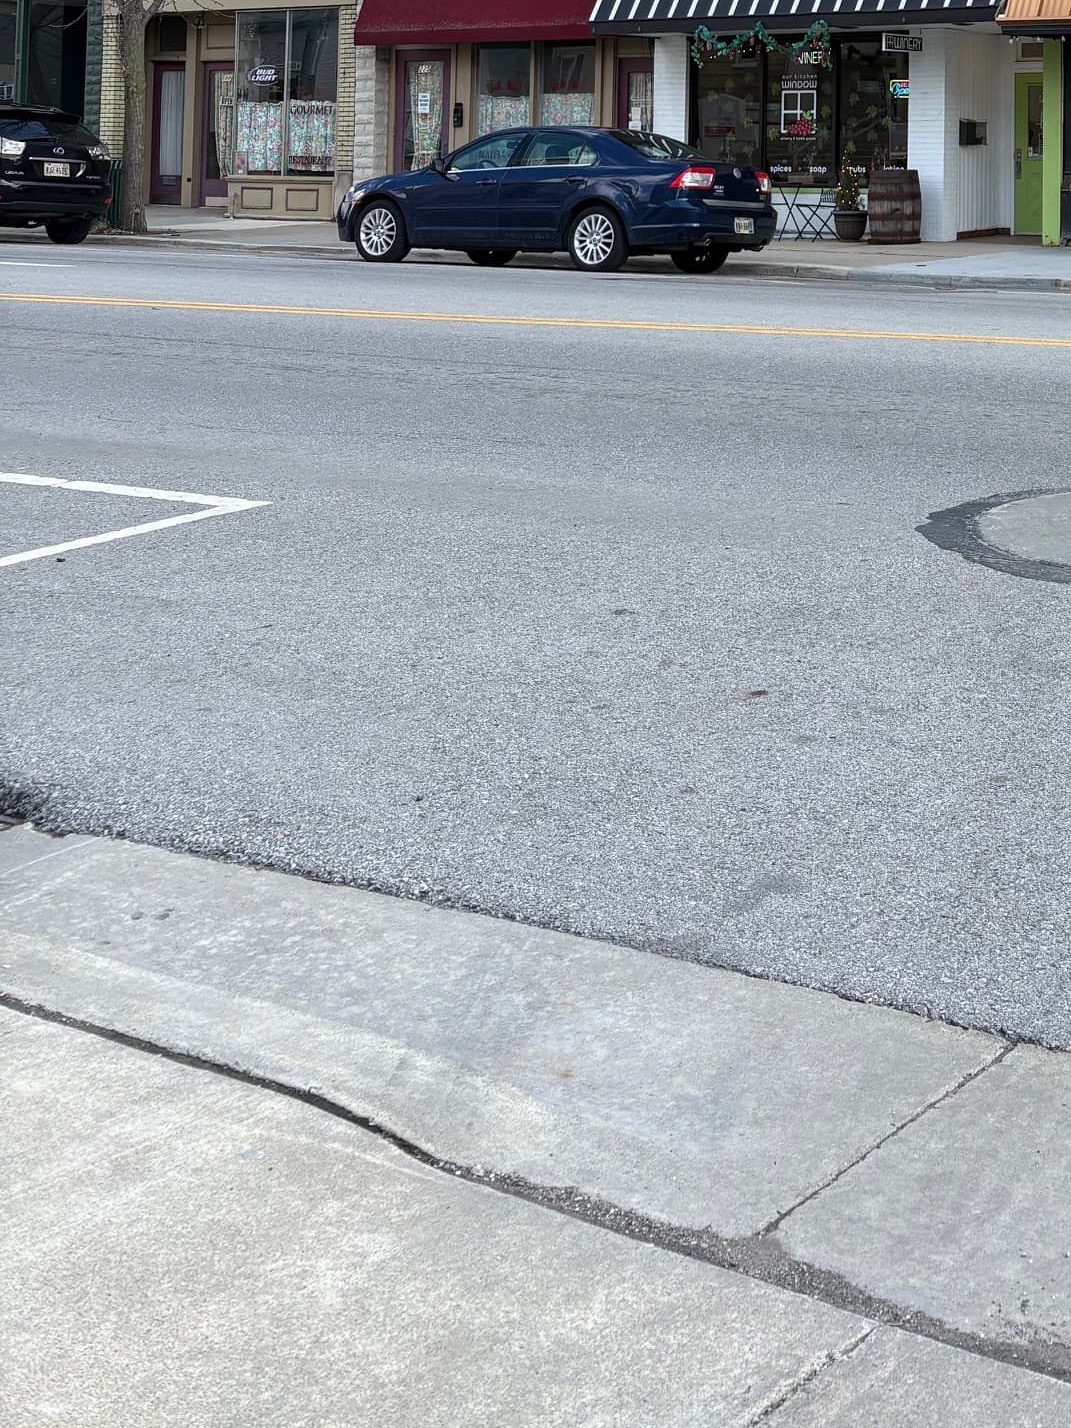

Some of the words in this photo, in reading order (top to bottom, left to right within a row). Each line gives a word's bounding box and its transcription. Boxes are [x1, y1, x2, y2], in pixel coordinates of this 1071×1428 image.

[894, 36, 922, 51] WINERY
[251, 74, 278, 82] LIGHT
[291, 105, 333, 115] GOURMET
[769, 165, 793, 174] spices
[809, 166, 828, 174] soap
